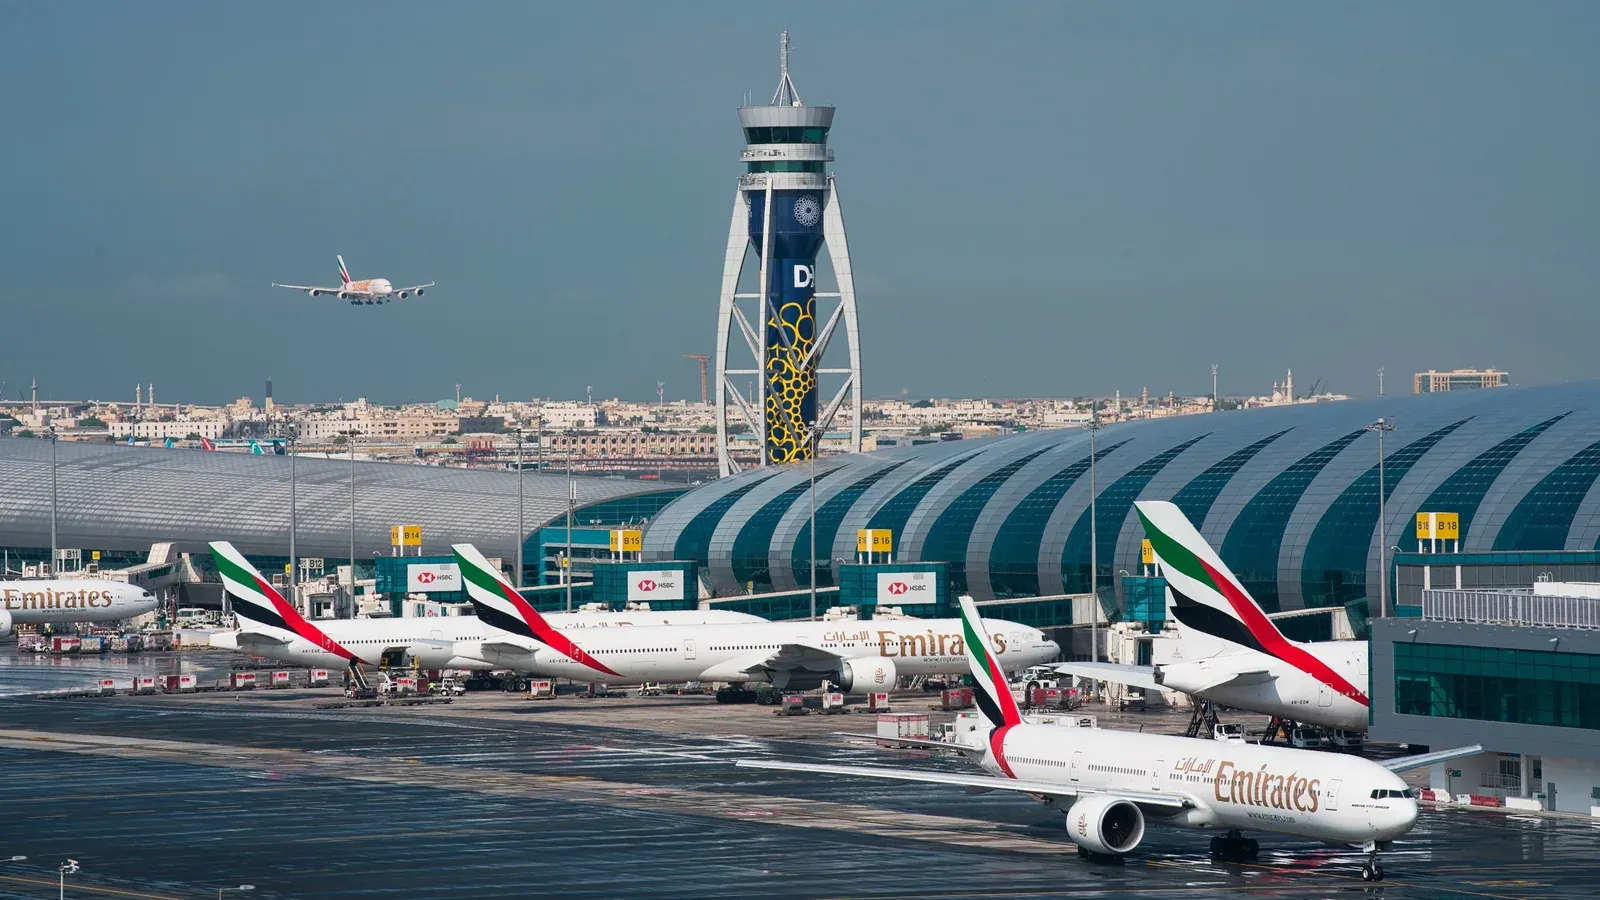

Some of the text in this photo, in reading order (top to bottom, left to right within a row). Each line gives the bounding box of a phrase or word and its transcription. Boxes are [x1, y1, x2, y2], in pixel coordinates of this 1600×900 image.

[1438, 522, 1457, 530] B 18
[310, 560, 322, 568] B12
[3, 587, 112, 610] Emirates
[824, 630, 870, 642] الإمارات
[876, 628, 1006, 658] Emiras
[1175, 757, 1216, 776] الإمارات
[1214, 760, 1320, 813] Emirates
